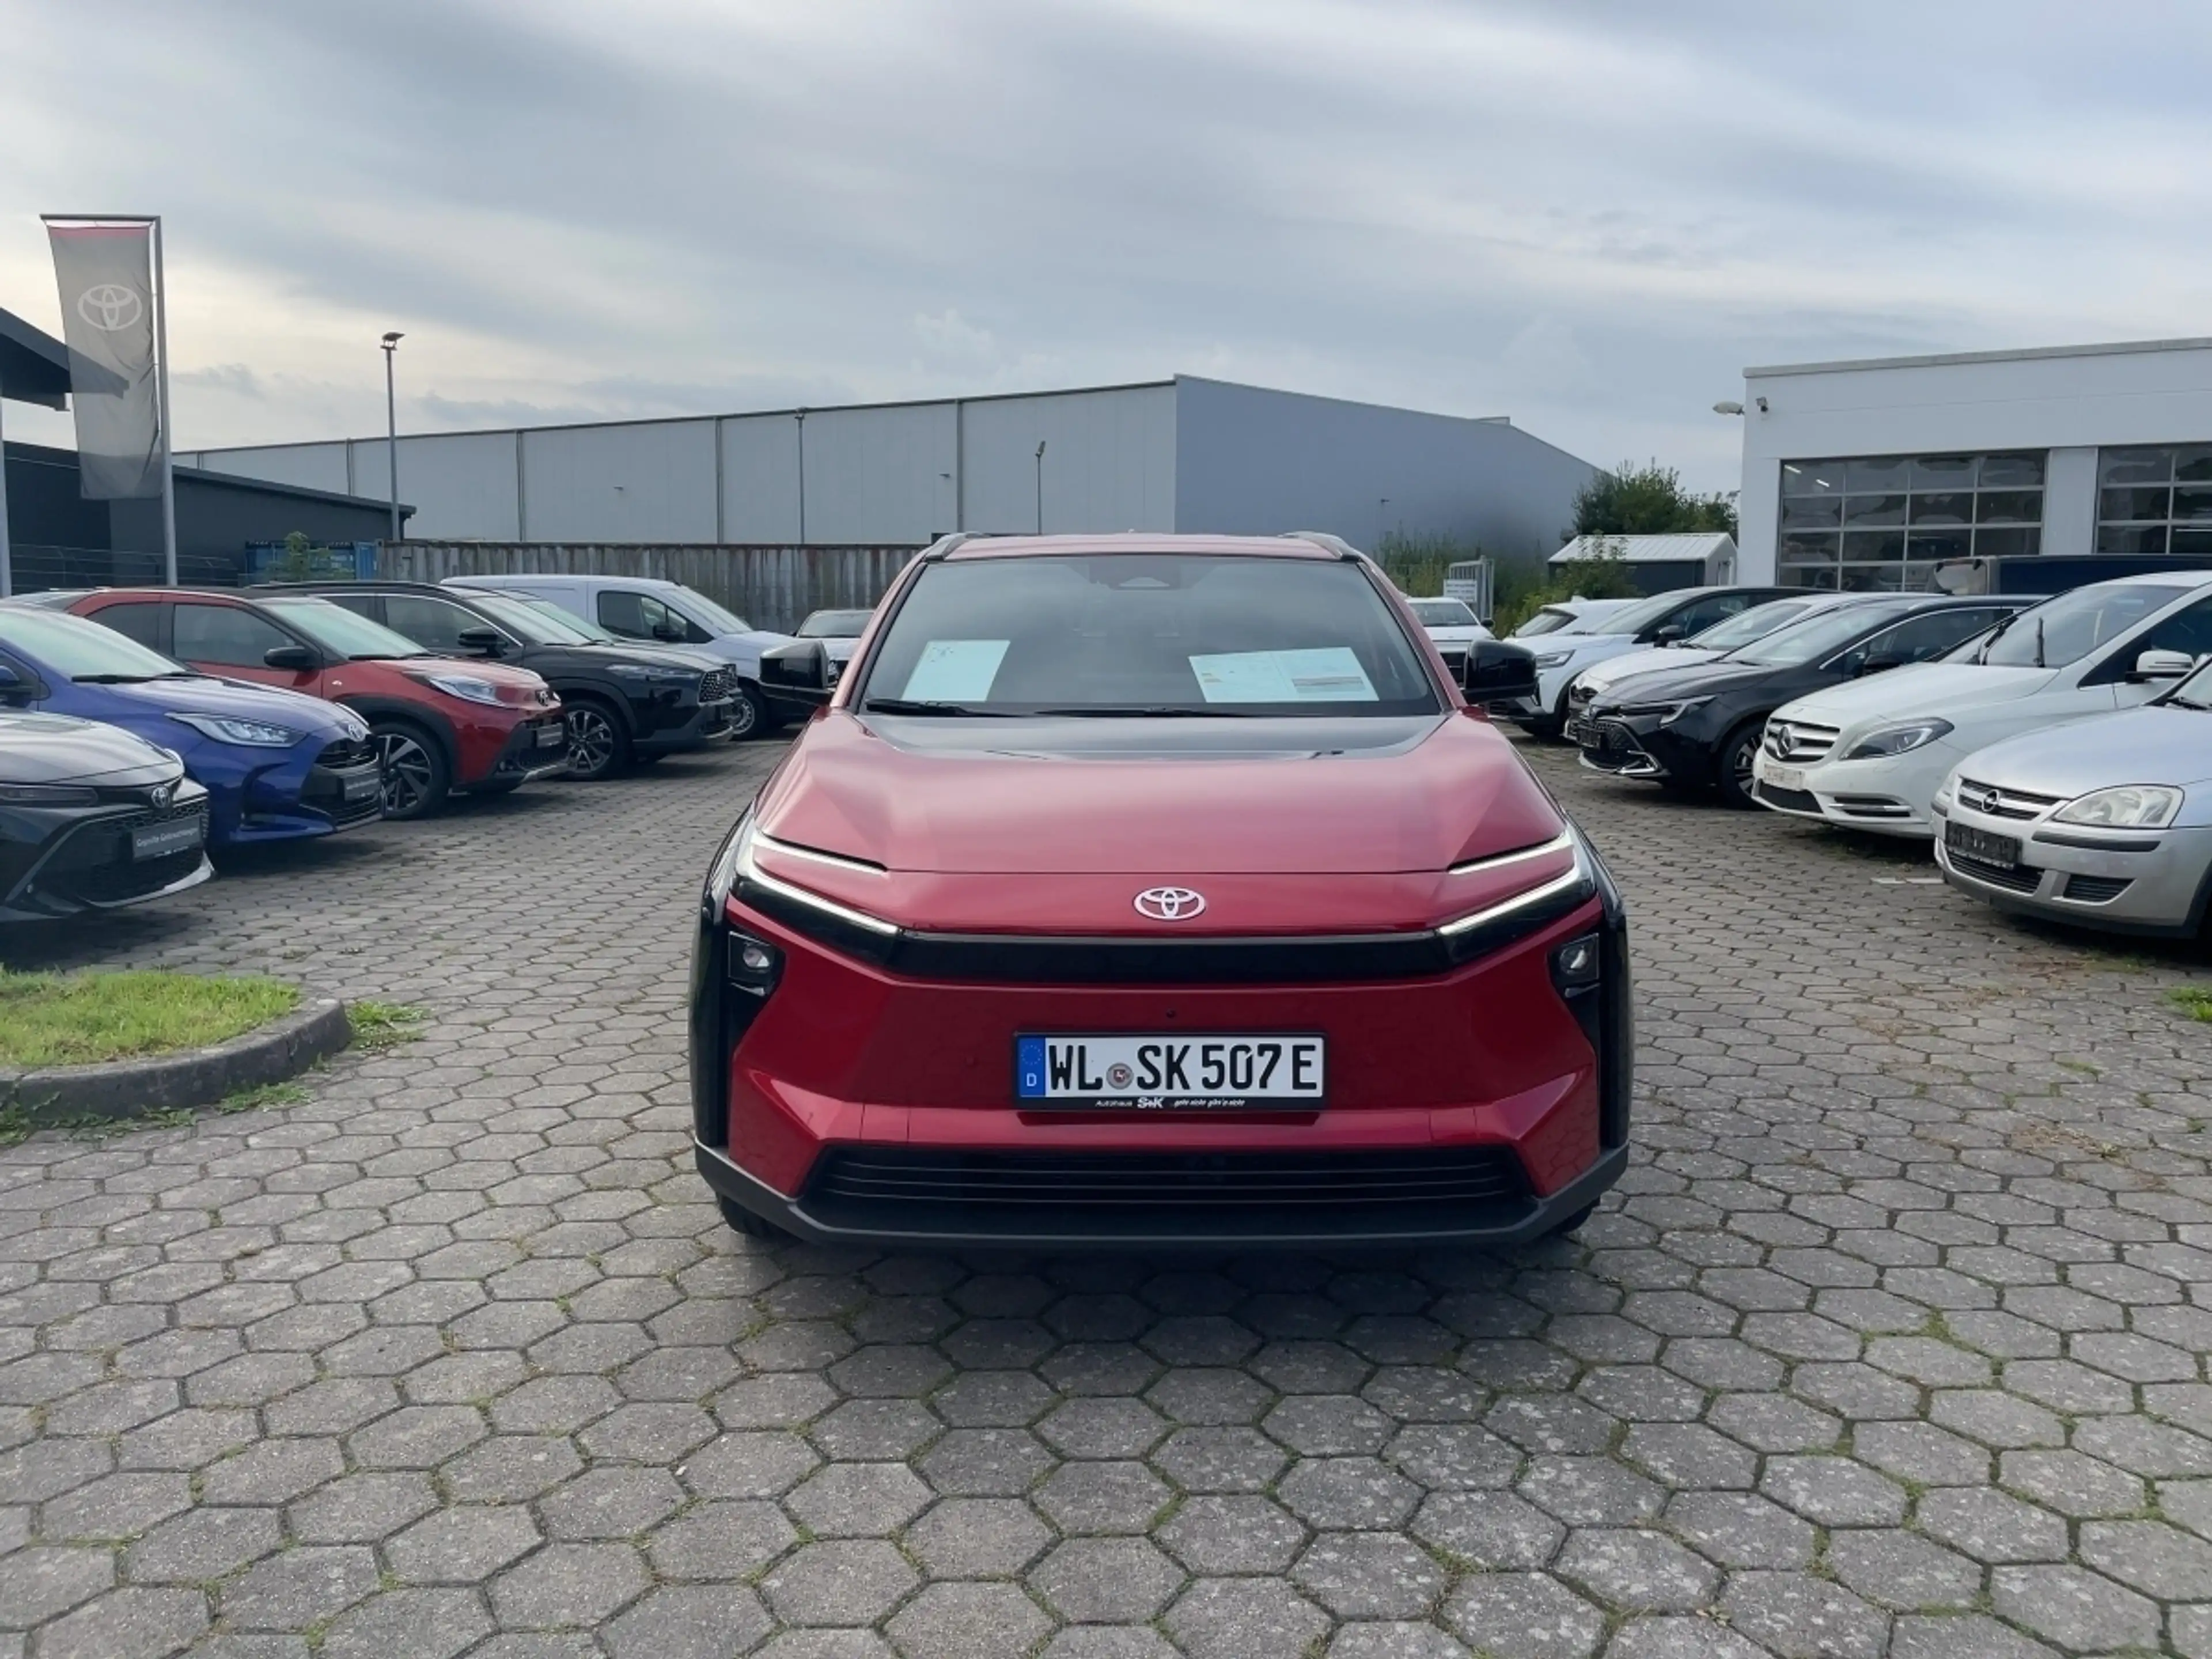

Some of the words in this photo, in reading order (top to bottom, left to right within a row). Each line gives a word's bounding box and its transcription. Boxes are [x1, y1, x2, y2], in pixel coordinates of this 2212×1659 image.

[1026, 1073, 1037, 1087] D
[1048, 1044, 1104, 1090] WL
[1137, 1044, 1191, 1090] SK
[1201, 1043, 1282, 1090] 507
[1292, 1044, 1317, 1090] E
